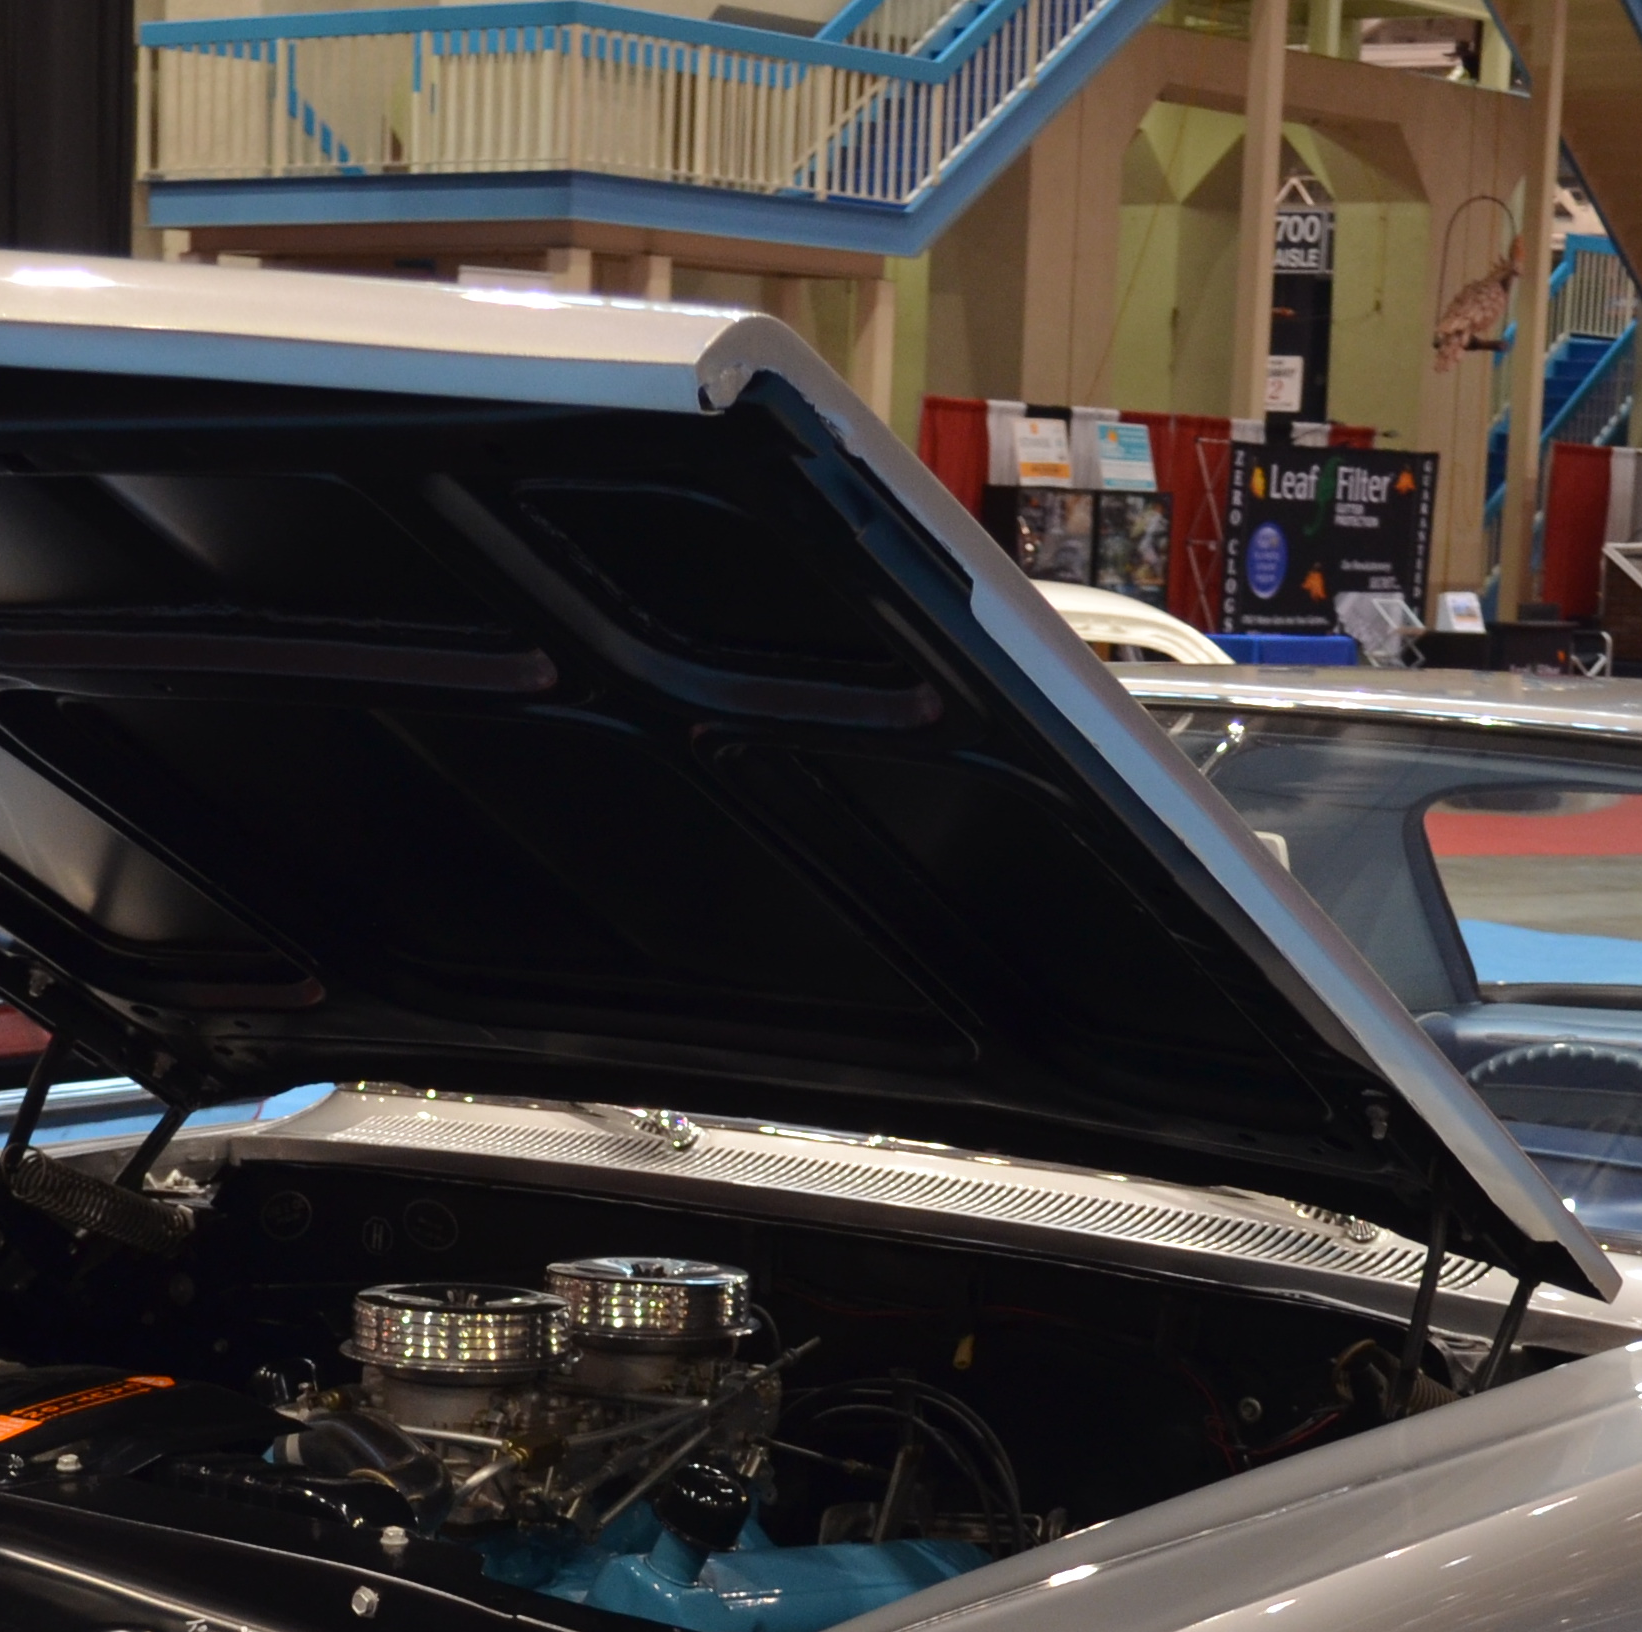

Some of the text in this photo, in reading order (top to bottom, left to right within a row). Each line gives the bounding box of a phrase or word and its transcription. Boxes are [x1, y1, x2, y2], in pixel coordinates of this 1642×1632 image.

[1275, 215, 1322, 243] 700
[1274, 248, 1321, 268] AISLE
[1231, 449, 1245, 525] ZERO
[1270, 464, 1392, 503] Leaf Filter
